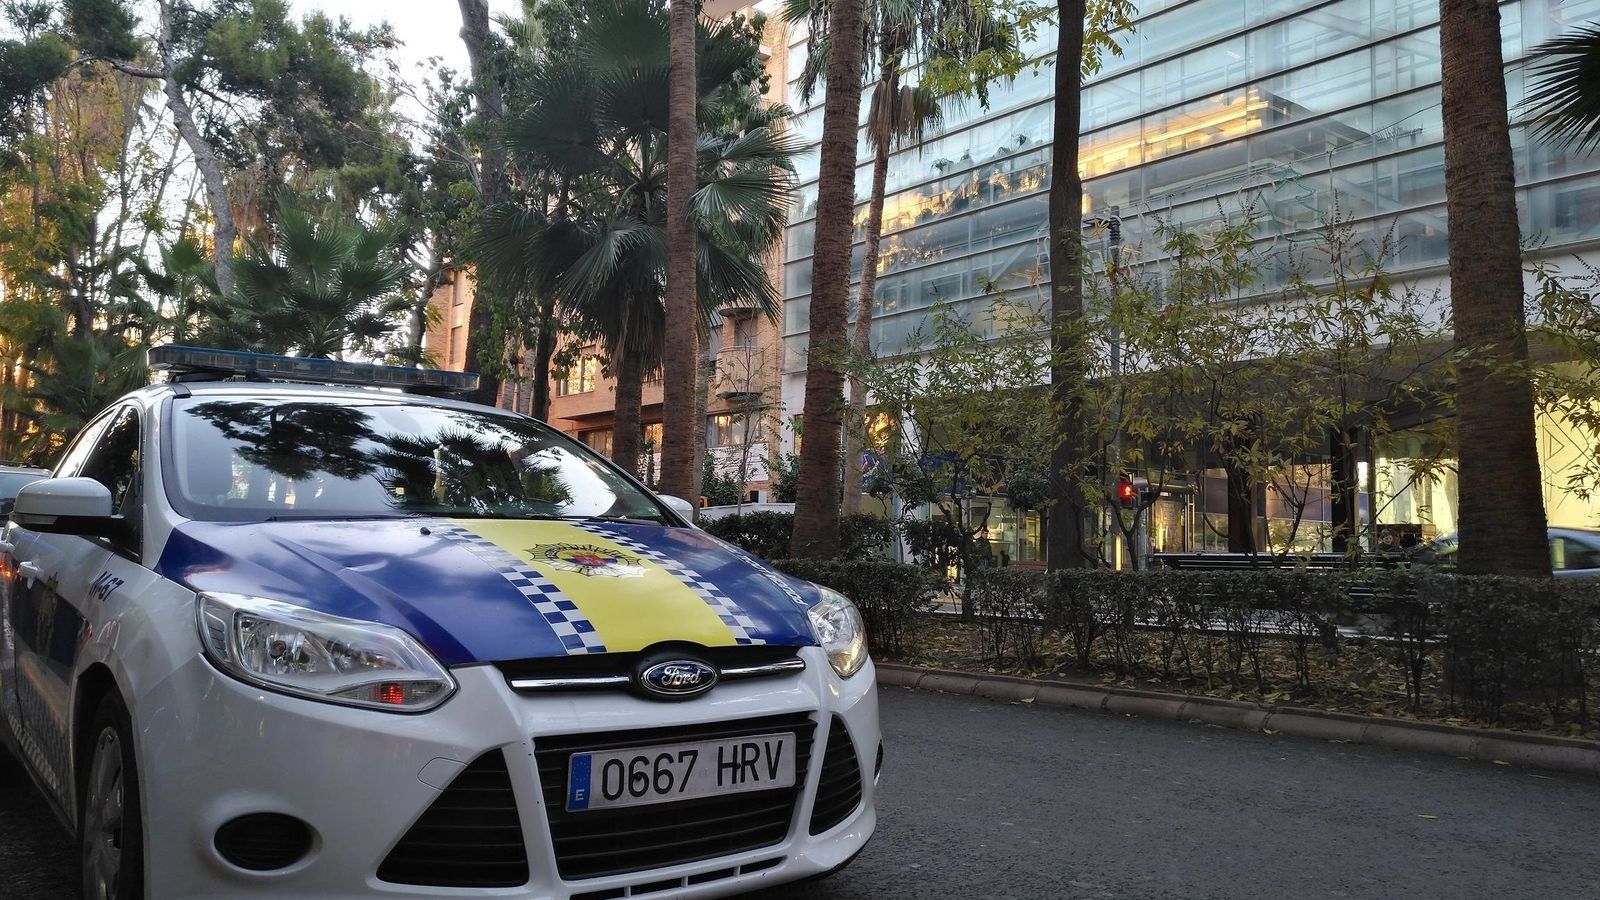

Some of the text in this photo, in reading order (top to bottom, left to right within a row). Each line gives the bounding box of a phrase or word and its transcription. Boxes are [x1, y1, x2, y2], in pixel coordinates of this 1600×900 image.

[661, 665, 701, 686] Ford
[601, 740, 783, 801] 0667 HRV
[575, 789, 585, 800] E
